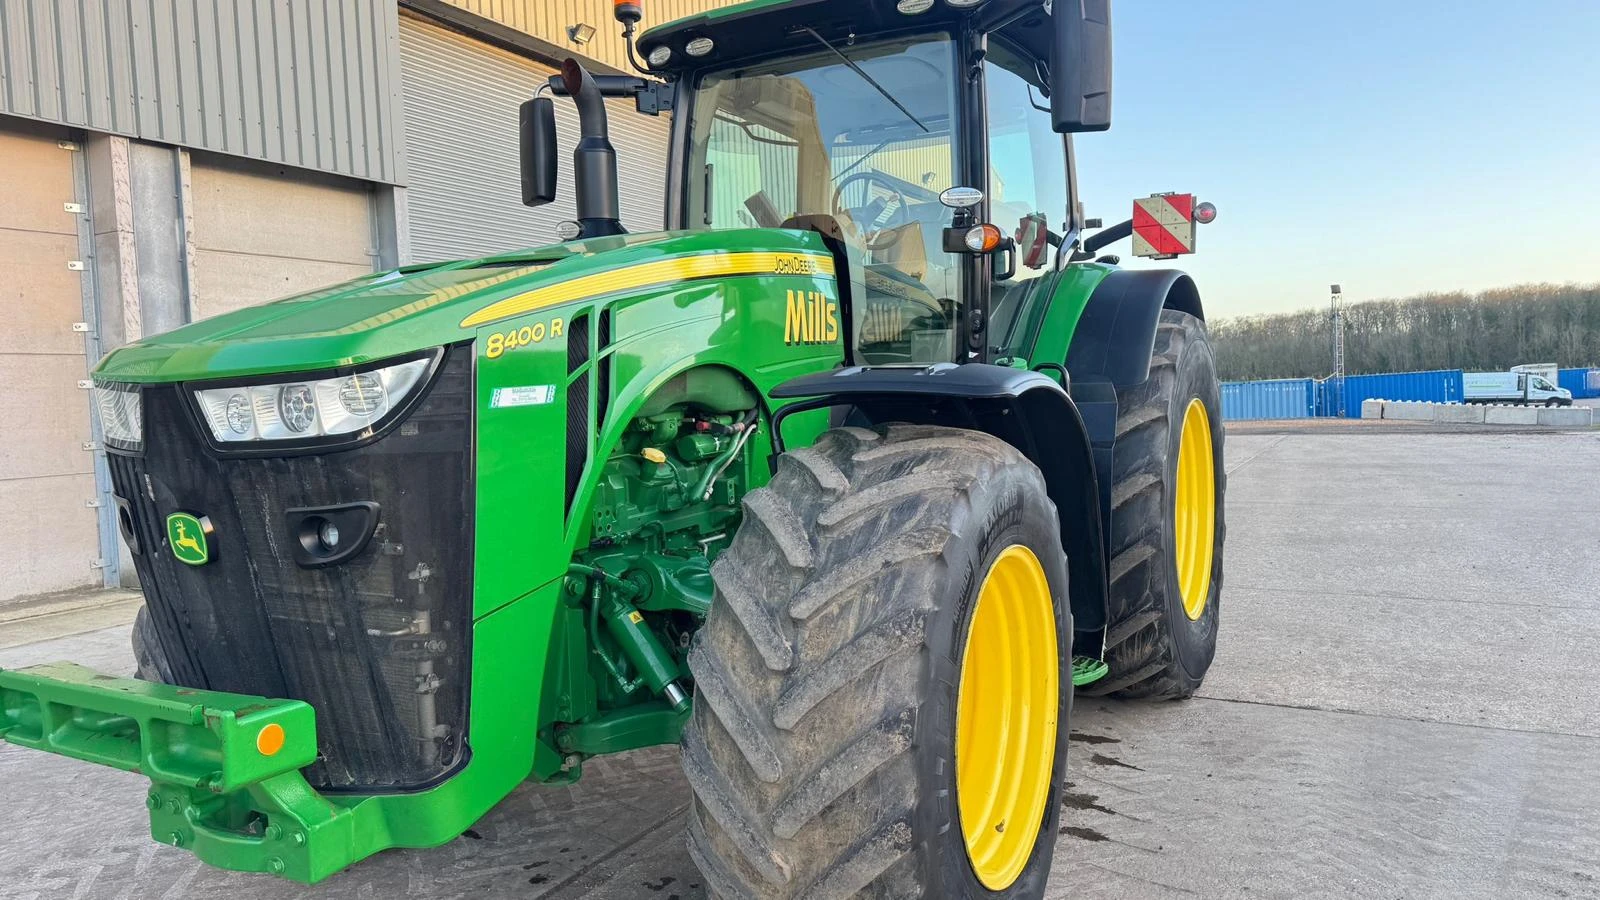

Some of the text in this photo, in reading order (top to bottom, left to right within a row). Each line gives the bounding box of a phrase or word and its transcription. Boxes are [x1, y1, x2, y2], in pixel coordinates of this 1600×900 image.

[486, 317, 563, 359] 8400 R
[784, 289, 838, 345] Mills
